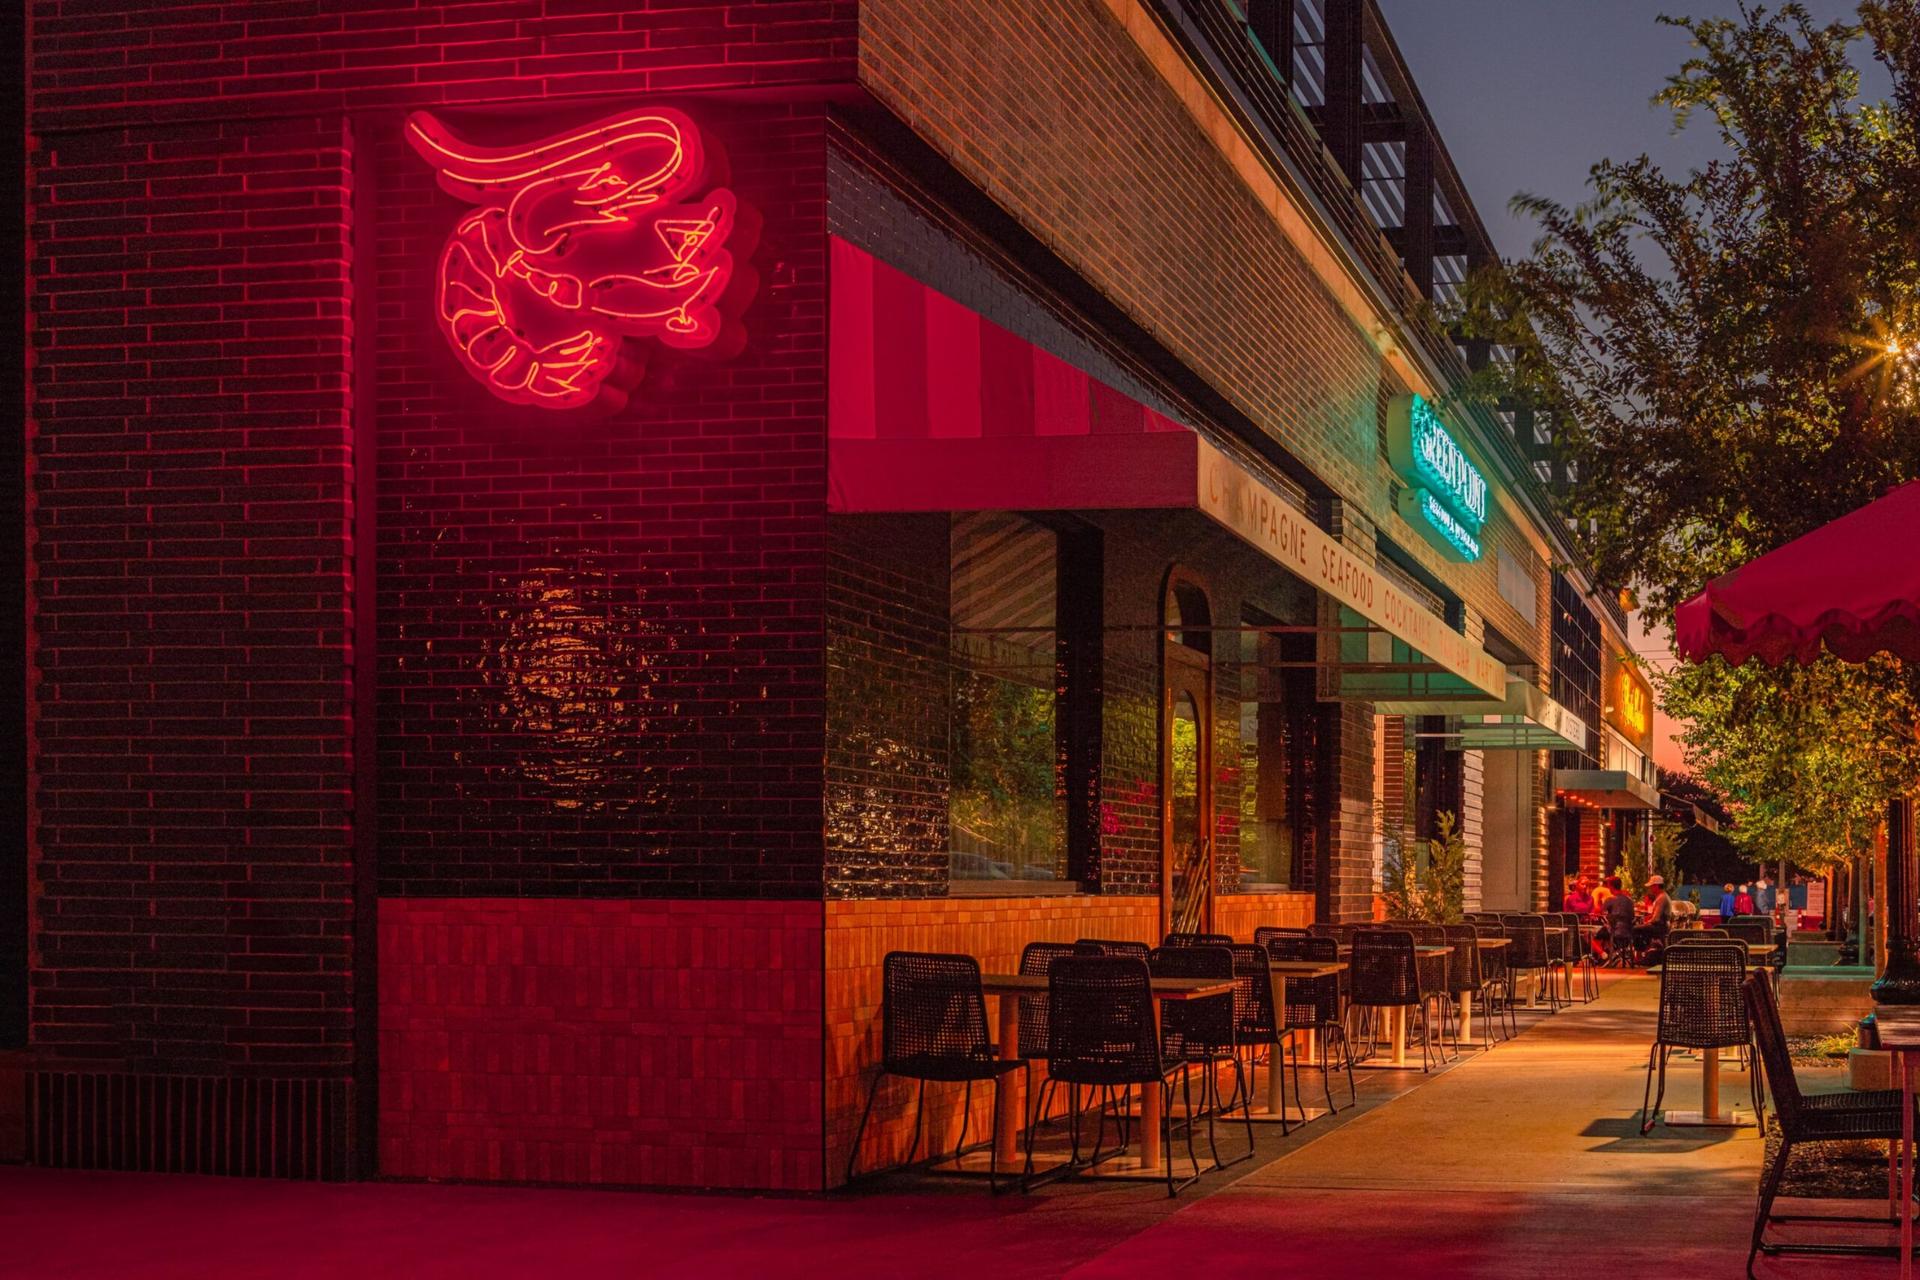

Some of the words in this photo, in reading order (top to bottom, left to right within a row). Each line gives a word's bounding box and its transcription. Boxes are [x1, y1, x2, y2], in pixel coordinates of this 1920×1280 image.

[1208, 462, 1307, 565] CHAMPAGNE
[1321, 545, 1374, 609] SEAFOOD
[1384, 589, 1430, 648] COCKTAILS
